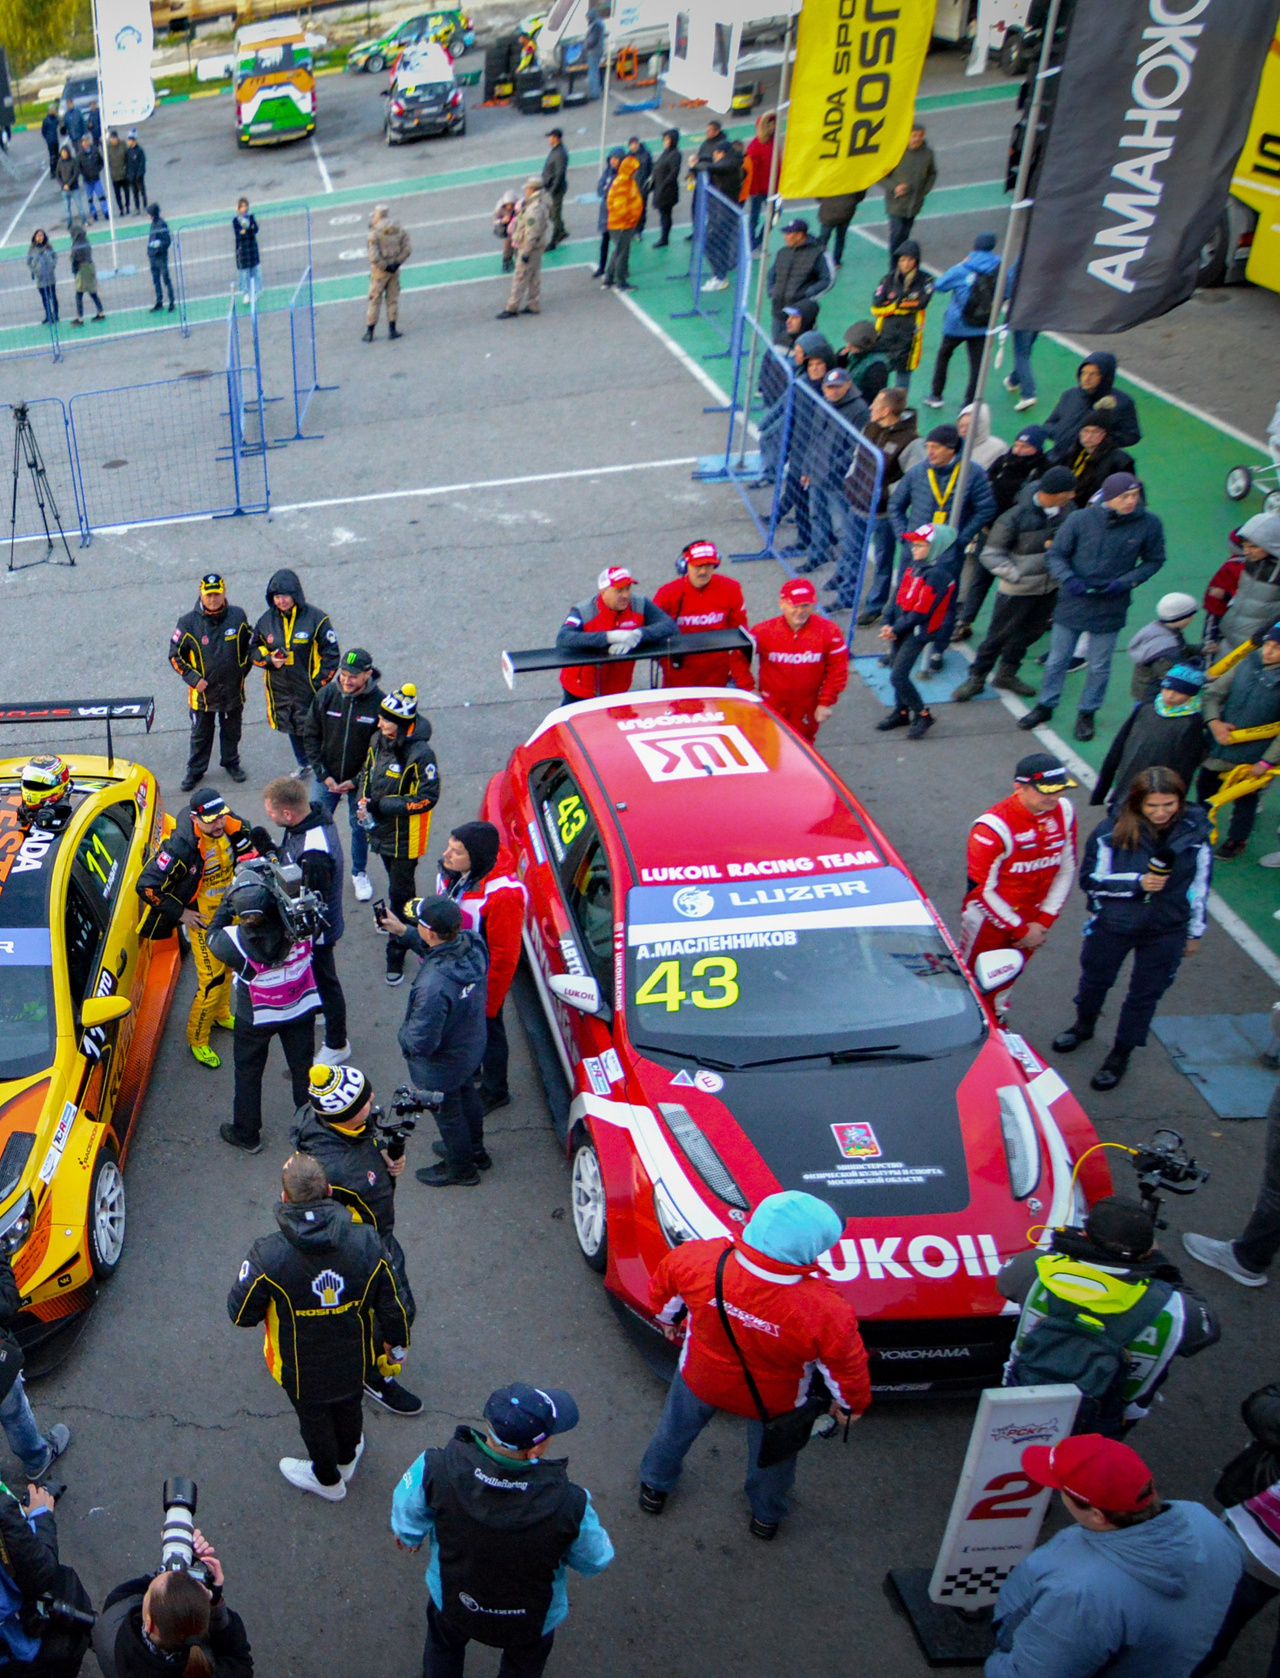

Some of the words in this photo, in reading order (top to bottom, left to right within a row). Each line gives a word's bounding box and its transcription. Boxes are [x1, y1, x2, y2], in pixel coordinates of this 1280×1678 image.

[819, 87, 847, 159] LADA
[77, 704, 141, 716] LADA
[557, 795, 588, 845] 43
[11, 826, 55, 874] ADA
[86, 833, 113, 884] 11
[1009, 852, 1061, 874] ЛУКОЙ
[641, 864, 723, 883] LUKOIL
[728, 856, 814, 878] RACING
[817, 850, 880, 869] TEAM
[730, 880, 870, 908] LUZAR
[197, 931, 214, 978] ROSNEFT
[636, 931, 798, 960] А.МАСЛЕННИКОВ
[564, 988, 596, 1001] LUKOIL
[635, 956, 740, 1013] 43
[83, 1124, 99, 1166] RACEROOM
[802, 1171, 858, 1180] ФИЗИЧЕСКОЙ
[859, 1169, 901, 1178] КУЛЬТУРЫ
[910, 1168, 944, 1176] СПОРТА
[827, 1177, 885, 1186] МОСКОВСКОЙ
[836, 1162, 902, 1171] МИНИСТЕРСТВО
[812, 1233, 1004, 1281] UKOIL
[295, 1300, 362, 1317] ROSNEFT
[880, 1347, 970, 1360] YOKOHAMA
[966, 1470, 1046, 1521] 2
